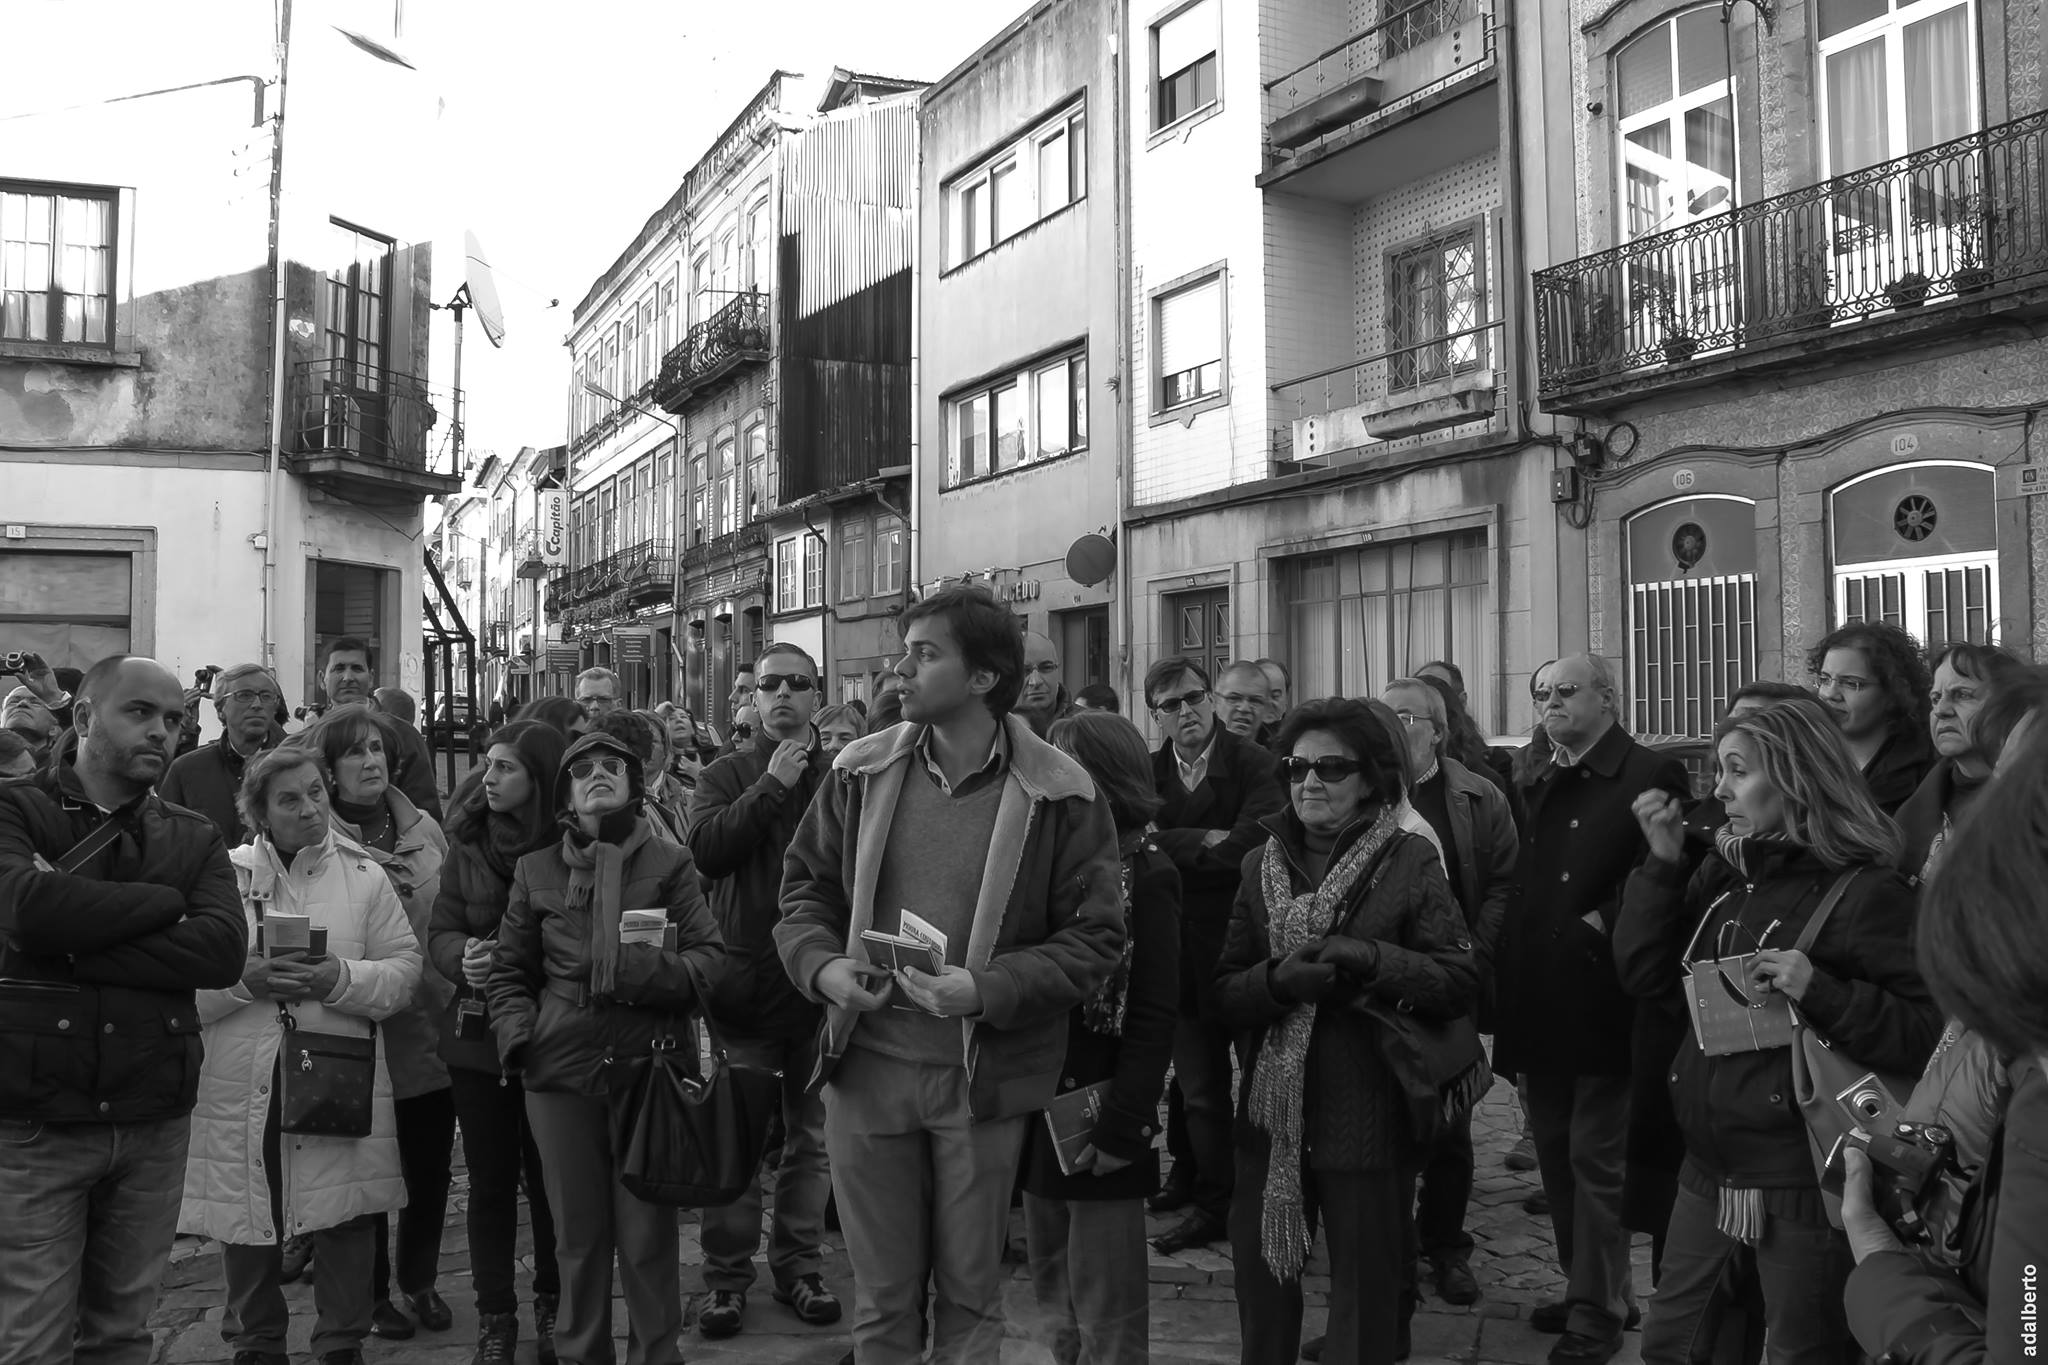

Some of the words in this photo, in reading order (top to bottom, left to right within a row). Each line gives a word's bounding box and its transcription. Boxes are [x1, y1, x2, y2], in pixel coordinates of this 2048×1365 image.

[1895, 437, 1914, 451] 104
[1676, 473, 1693, 486] 106
[546, 497, 564, 556] Capitão
